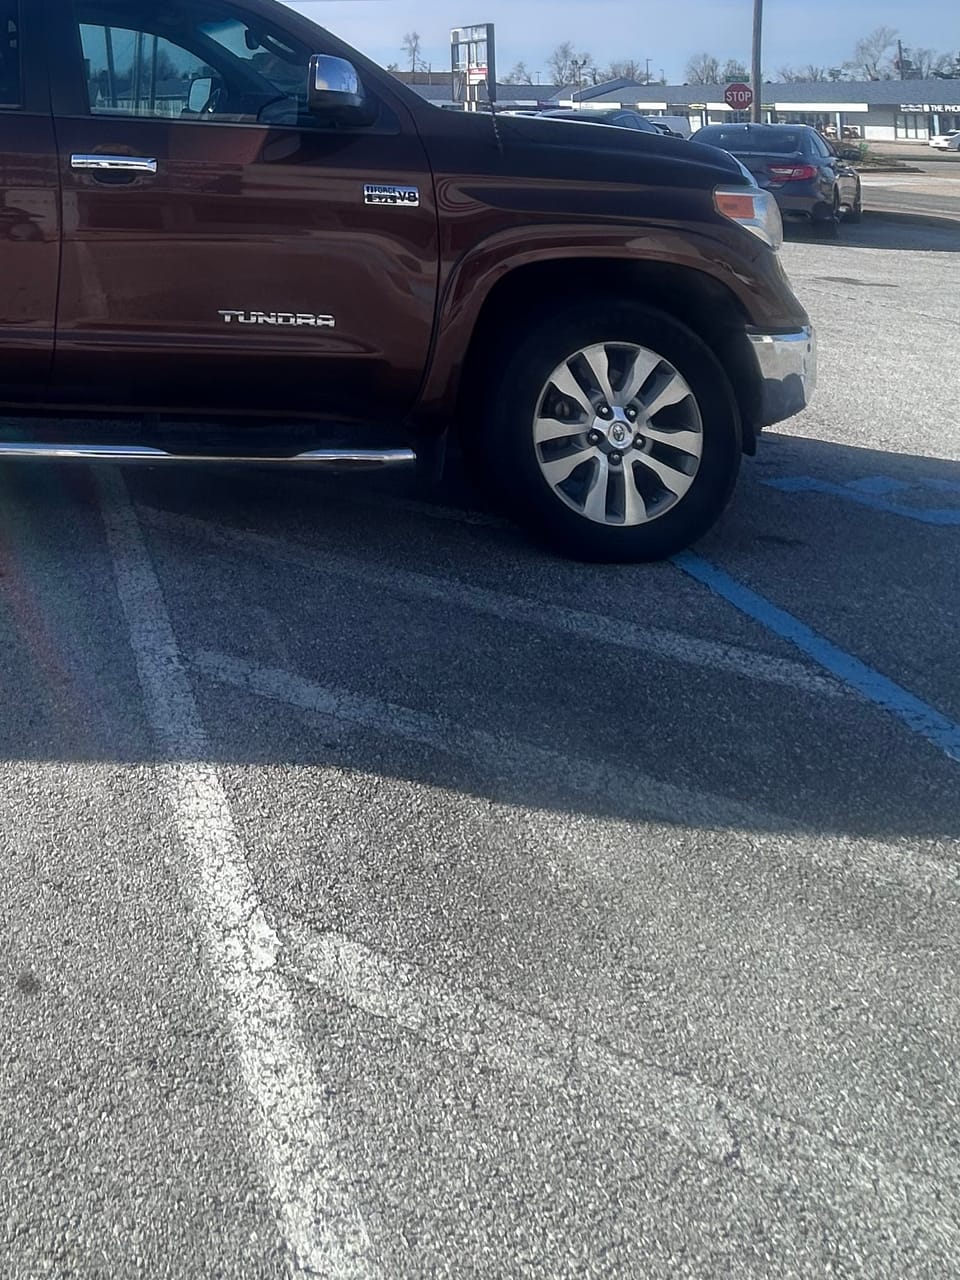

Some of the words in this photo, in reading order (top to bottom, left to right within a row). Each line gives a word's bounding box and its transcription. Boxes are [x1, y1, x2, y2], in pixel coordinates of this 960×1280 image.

[726, 91, 752, 102] STOP
[930, 104, 944, 112] THE
[396, 191, 418, 203] V8
[217, 309, 336, 328] TUNDRA
